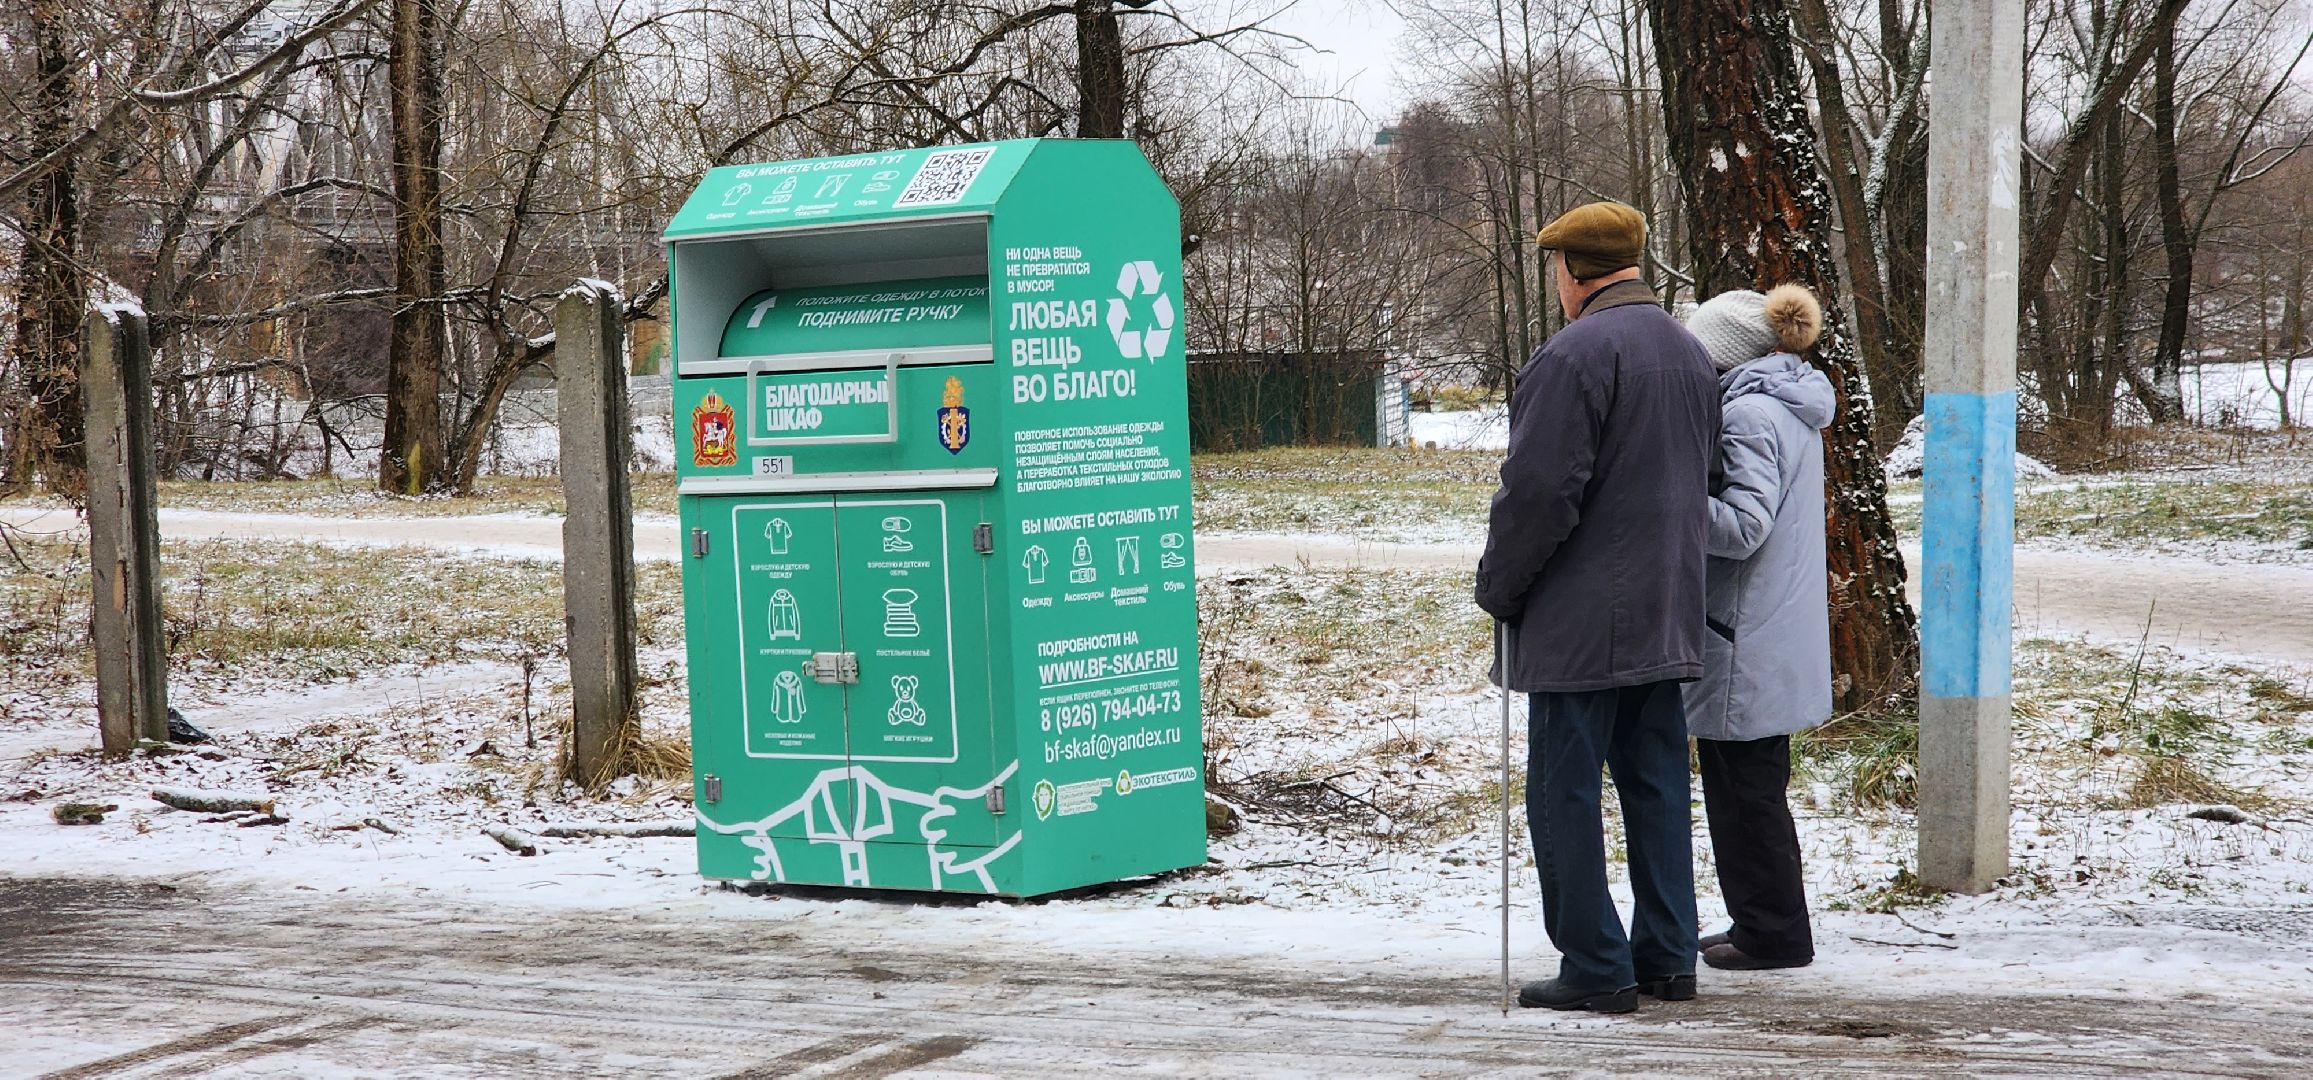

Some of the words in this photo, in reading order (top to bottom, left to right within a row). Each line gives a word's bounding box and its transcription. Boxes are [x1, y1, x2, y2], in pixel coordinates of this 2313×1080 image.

[736, 169, 756, 179] ВЫ
[757, 163, 812, 177] МОЖЕТЕ
[813, 159, 876, 172] ОСТАВИТЬ
[880, 154, 907, 166] ТУТ
[1006, 248, 1021, 261] НИ
[1023, 248, 1052, 262] ОДНА
[1053, 246, 1082, 261] ВЕЩЬ
[1006, 264, 1021, 277] НЕ
[1022, 262, 1090, 276] ПРЕВРАТИТСЯ
[796, 294, 867, 306] ПОЛОЖИТЕ
[870, 290, 929, 303] ОДЕЖДУ
[928, 289, 939, 299] В
[940, 287, 989, 298] ЛОТОК
[1008, 281, 1015, 293] В
[1017, 280, 1055, 292] МУСОР!
[798, 307, 904, 328] ПОДНИМИТЕ
[906, 304, 964, 322] РУЧКУ
[1009, 299, 1097, 331] ЛЮБАЯ
[1011, 336, 1082, 370] ВЕЩЬ
[1013, 373, 1047, 404] ВО
[1053, 368, 1137, 401] БЛАГО!
[766, 407, 823, 431] ШКАФ
[1014, 428, 1062, 442] ПОВТОРНОЕ
[1062, 424, 1128, 438] ИСПОЛЬЗОВАНИЕ
[1128, 421, 1164, 434] ОДЕЖДЫ
[1015, 441, 1062, 454] ПОЗВОЛЯЕТ
[1062, 438, 1096, 451] ПОМОЧЬ
[1096, 435, 1143, 448] СОЦИАЛЬНО
[762, 458, 784, 474] 551
[1016, 452, 1085, 467] НЕЗАЩИЩЁННЫМ
[1086, 449, 1114, 461] СЛОЯМ
[1115, 446, 1161, 459] НАСЕЛЕНИЯ,
[1016, 469, 1023, 480] А
[1024, 465, 1078, 479] ПЕРЕРАБОТКА
[1079, 460, 1133, 475] ТЕКСТИЛЬНЫХ
[1134, 457, 1169, 470] ОТХОДОВ
[1017, 478, 1073, 493] БЛАГОТВОРНО
[1074, 475, 1105, 488] ВЛИЯЕТ
[1105, 473, 1117, 485] НА
[1117, 471, 1140, 483] НАШУ
[1141, 469, 1182, 482] ЭКОЛОГИЮ
[1022, 518, 1041, 535] ВЫ
[1044, 513, 1095, 533] МОЖЕТЕ
[1098, 508, 1155, 527] ОСТАВИТЬ
[1157, 505, 1180, 521] ТУТ
[1064, 591, 1105, 603] Аксессуары
[1110, 584, 1149, 599] Домашний
[1163, 580, 1186, 592] Обувь
[1022, 596, 1053, 609] Одежду
[1038, 633, 1121, 657] ПОДРОБНОСТИ
[1123, 631, 1139, 646] НА
[1039, 647, 1178, 685] WWW.BF-SKAF.RU
[1041, 708, 1051, 731] 8
[1056, 702, 1097, 735] (926)
[1101, 690, 1181, 723] 794-04-73
[1045, 727, 1180, 763] bf-skaf@yandex.ru
[1132, 768, 1196, 787] ЭКОТЕКСТИЛЬ
